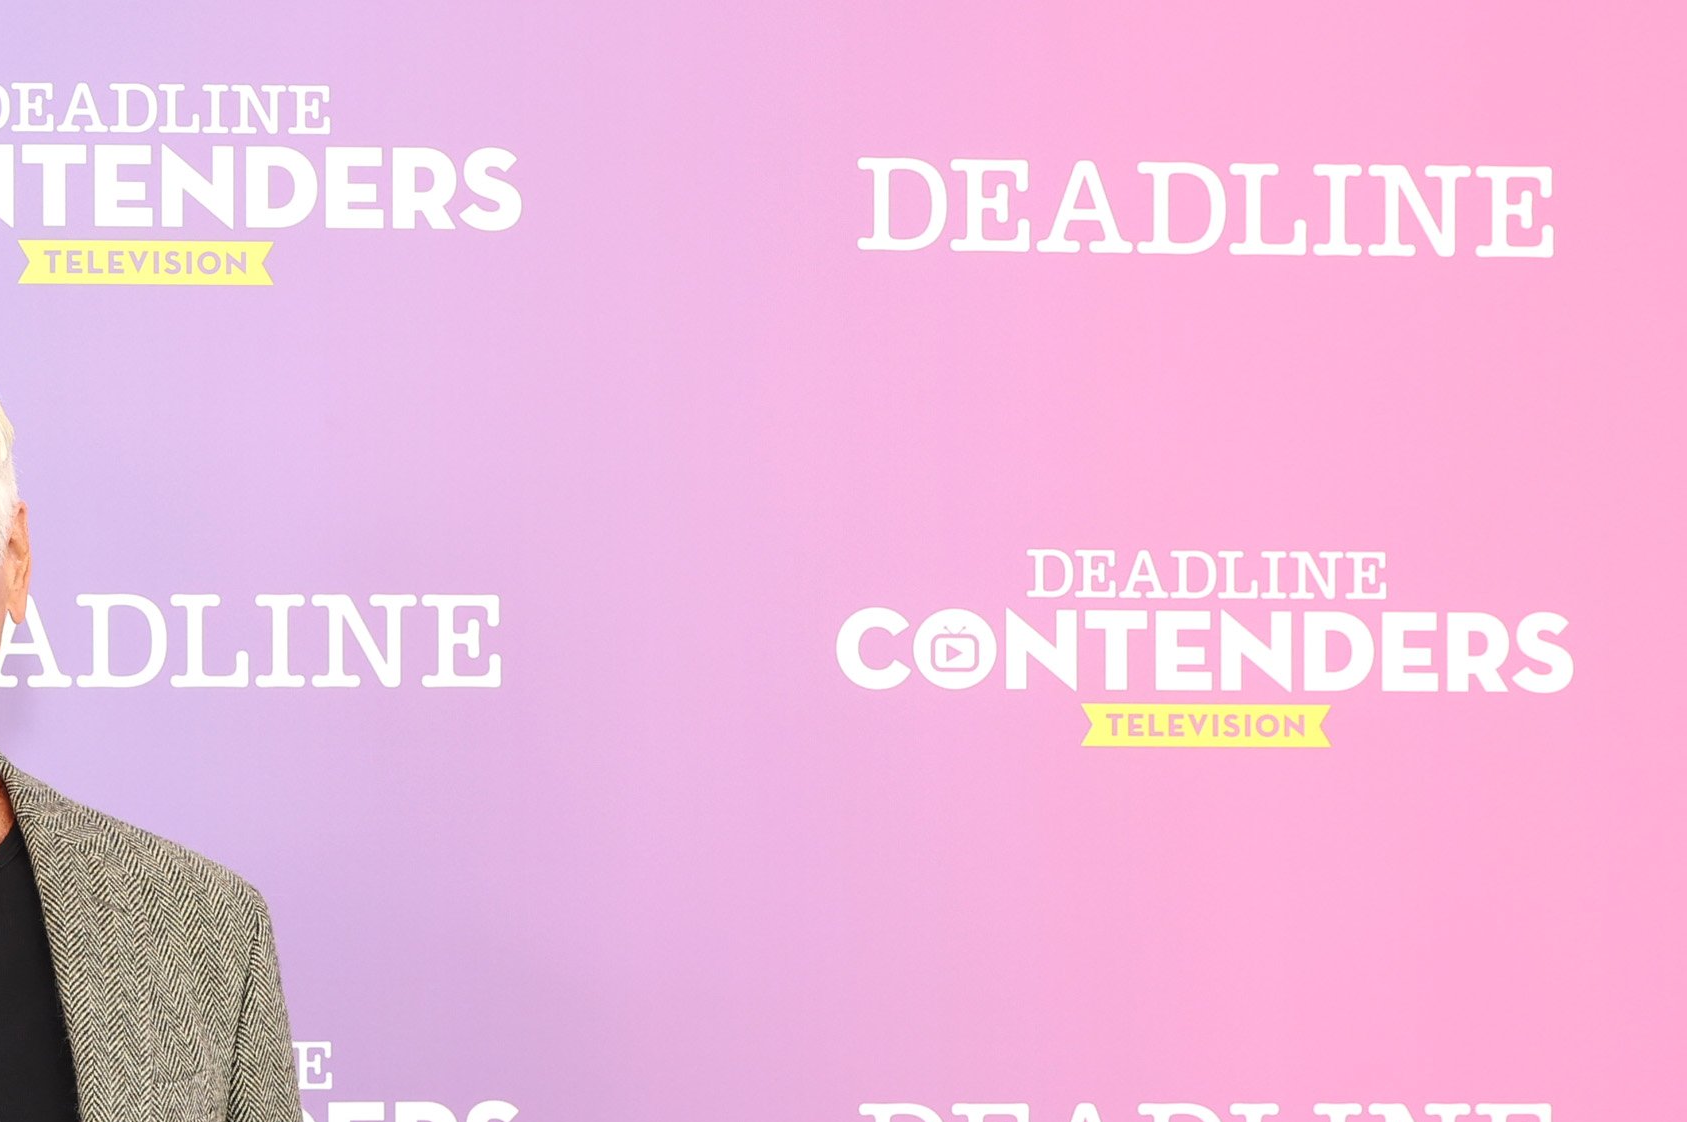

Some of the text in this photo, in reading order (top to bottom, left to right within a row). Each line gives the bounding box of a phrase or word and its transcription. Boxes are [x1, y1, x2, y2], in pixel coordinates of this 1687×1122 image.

[857, 157, 1554, 258] DEADLINE
[43, 249, 249, 277] TELEVISION
[1026, 548, 1387, 600] DEADLINE
[836, 606, 1574, 694] CONTENDERS
[1105, 712, 1306, 739] TELEVISION
